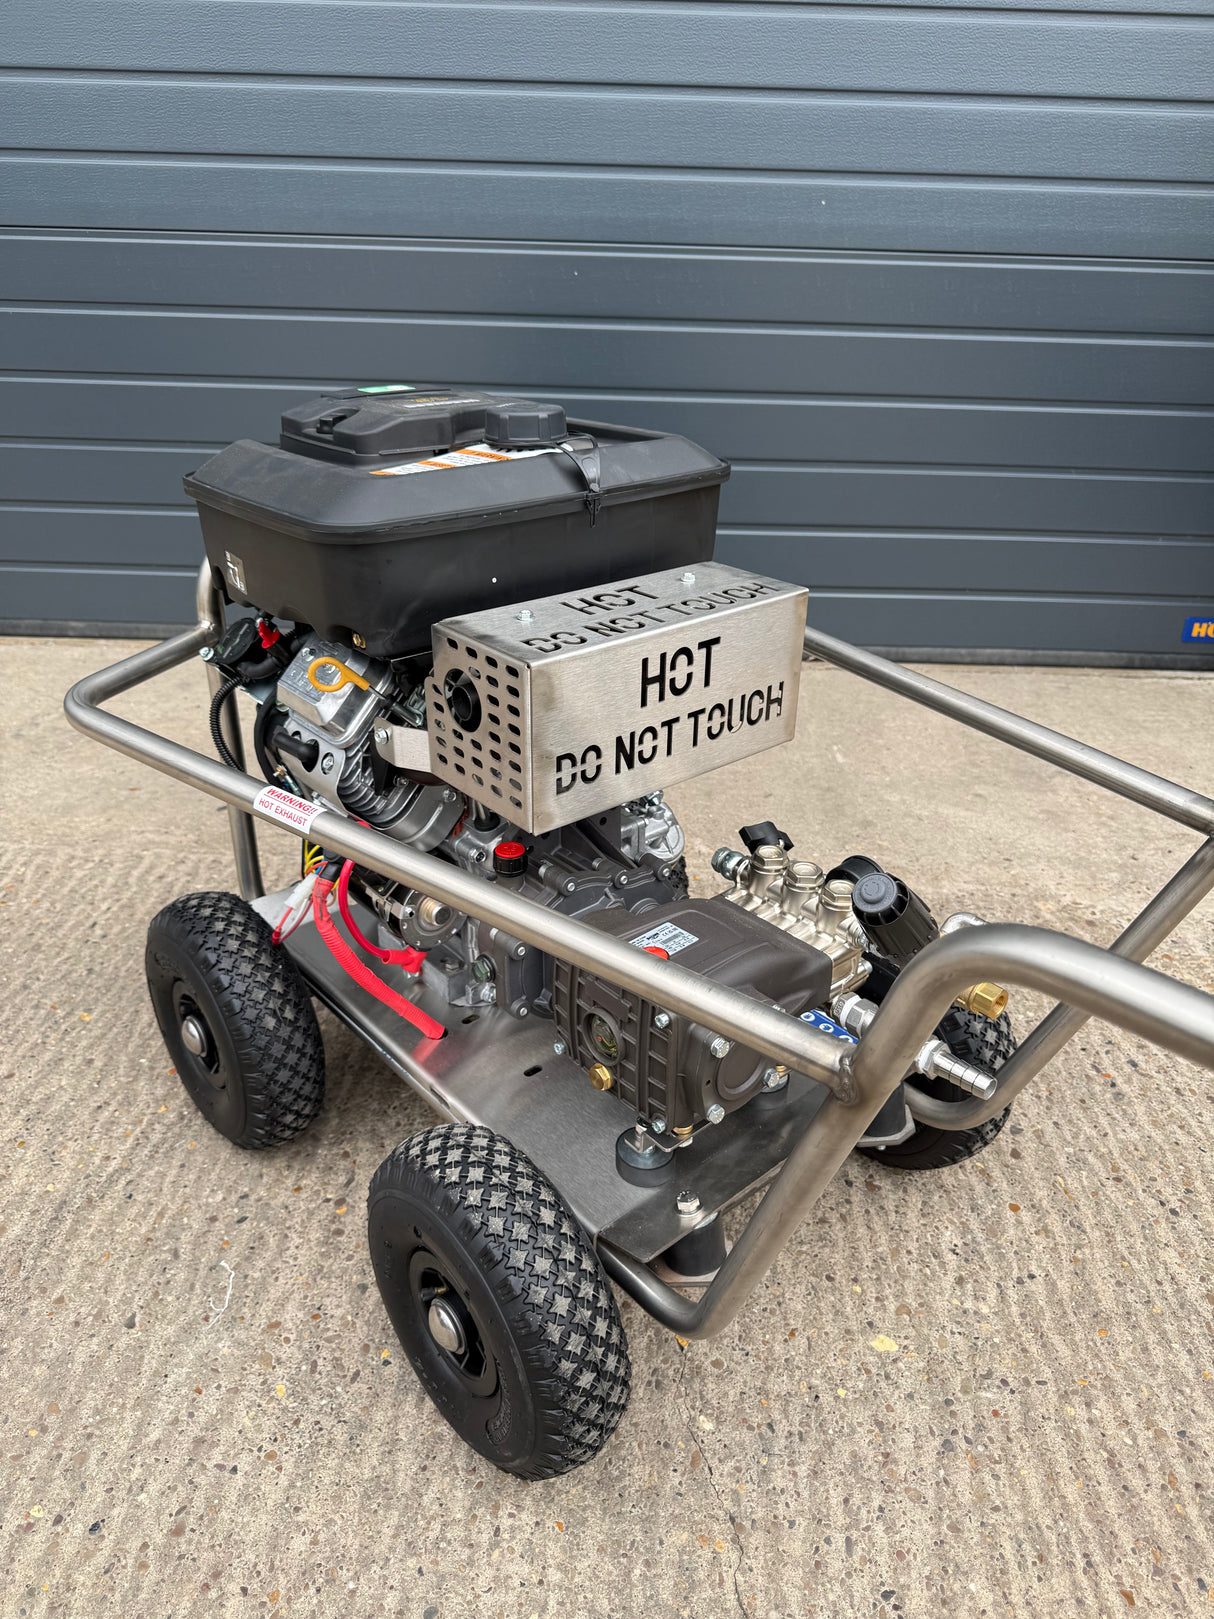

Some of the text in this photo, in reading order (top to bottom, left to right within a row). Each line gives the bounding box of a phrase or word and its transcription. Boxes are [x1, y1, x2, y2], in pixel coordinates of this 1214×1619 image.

[520, 582, 780, 653] DO NOT TOUCH
[561, 585, 659, 615] HOT
[640, 636, 721, 708] HOT
[556, 681, 784, 795] DO NOT TOUCH
[259, 798, 308, 826] HOT EXHAUST
[267, 788, 318, 815] WARNING!!
